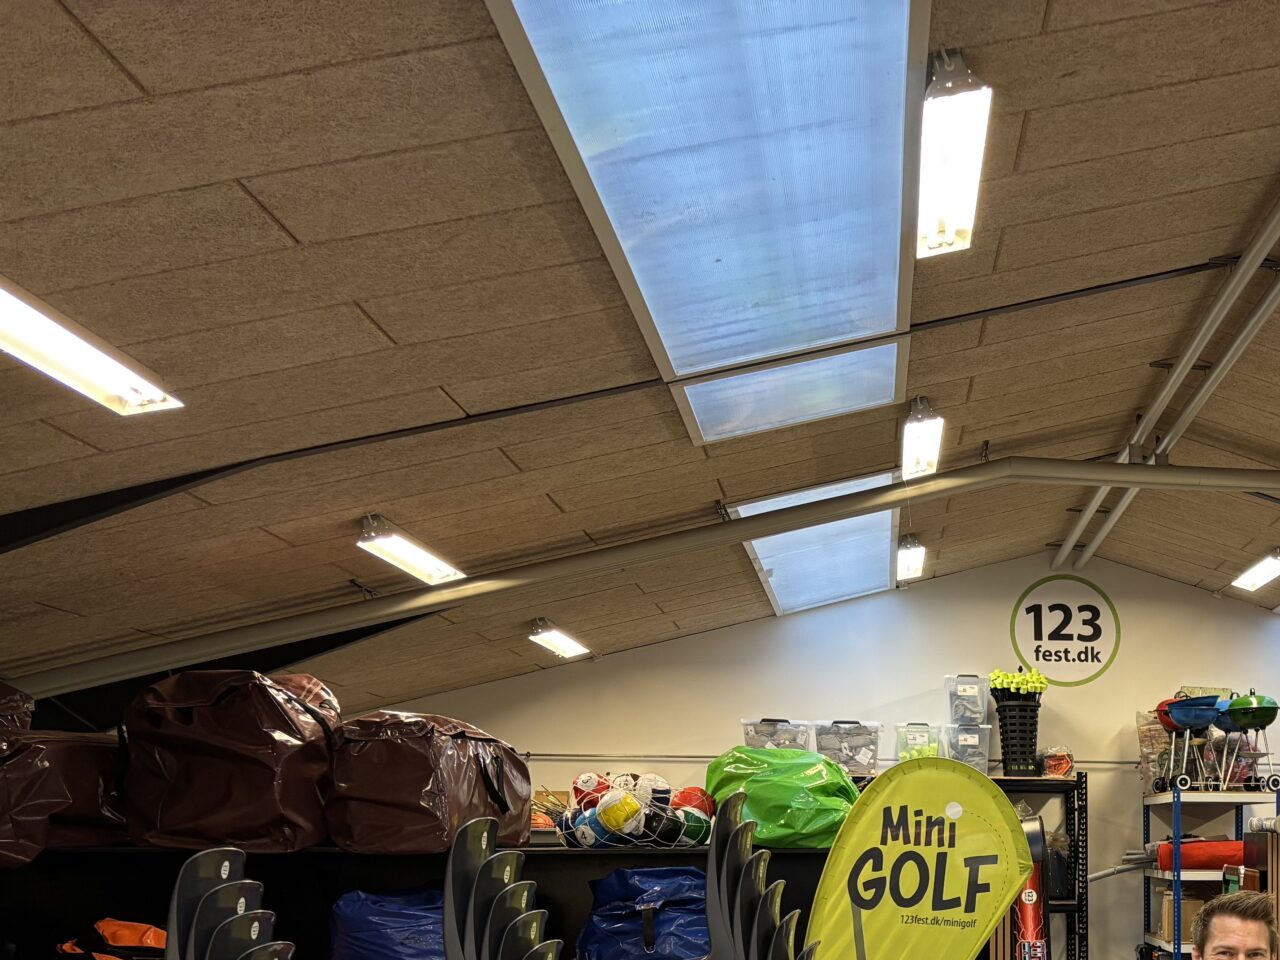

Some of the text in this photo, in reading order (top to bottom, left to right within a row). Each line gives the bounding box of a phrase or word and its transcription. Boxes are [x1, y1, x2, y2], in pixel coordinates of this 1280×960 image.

[1025, 603, 1103, 642] 123
[1034, 645, 1102, 663] fest.dk
[880, 804, 957, 848] Mini
[847, 847, 999, 914] GOLF
[1027, 890, 1035, 904] 123
[900, 914, 977, 930] 123fest.dk/minigolf
